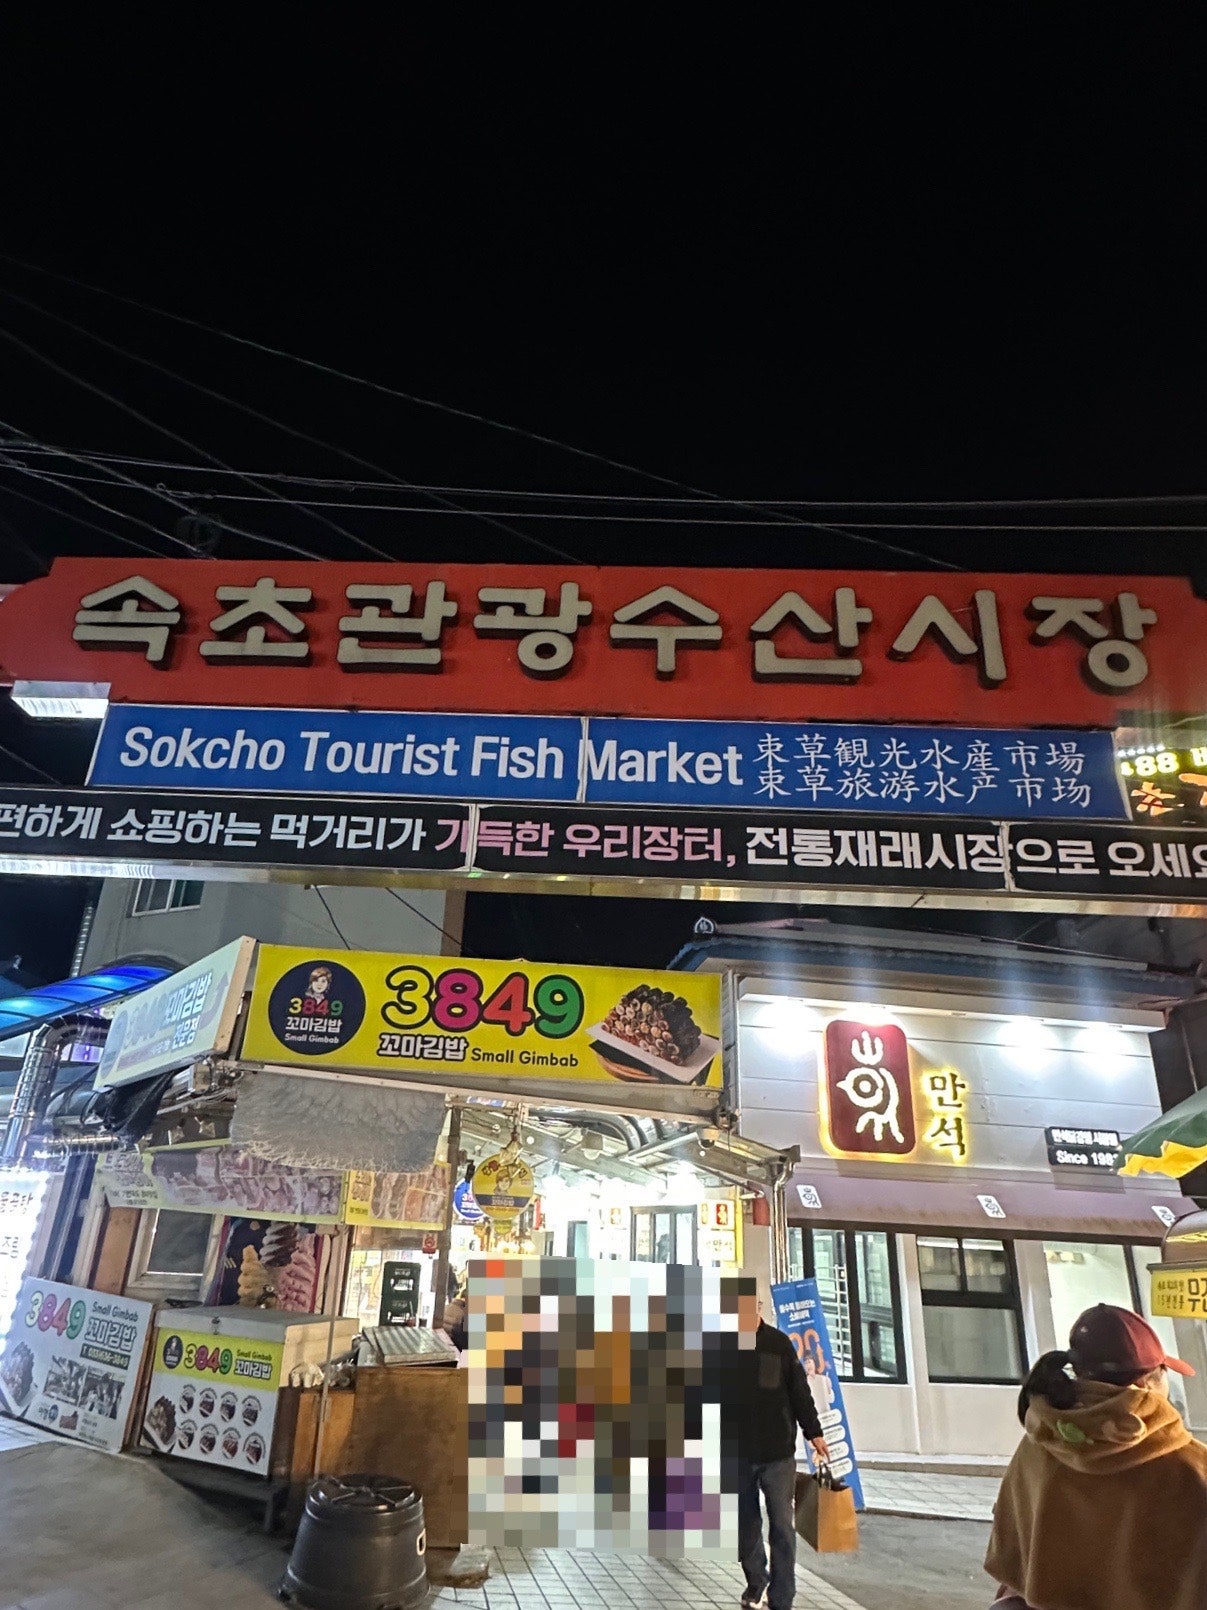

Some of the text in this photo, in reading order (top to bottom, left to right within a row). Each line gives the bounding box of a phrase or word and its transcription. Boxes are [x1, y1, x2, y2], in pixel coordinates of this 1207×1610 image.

[73, 574, 1158, 690] 속초관광수산시장
[119, 725, 743, 787] Sokcho Tourist Fish Market
[0, 803, 103, 840] 편하게
[107, 808, 262, 847] 쇼핑하는
[271, 813, 427, 852] 먹거리가
[435, 817, 555, 858] 가득한
[562, 822, 737, 868] 우리장터,
[745, 826, 1100, 876] 전통재래시장으로
[288, 997, 344, 1017] 3849
[380, 965, 585, 1039] 3849
[284, 1033, 340, 1044] Small Gimbab
[285, 1016, 343, 1034] 꼬마김밥
[376, 1033, 470, 1062] 꼬마김밥
[471, 1047, 579, 1068] Small Gimbab
[929, 1072, 966, 1156] 만석
[1056, 1149, 1089, 1165] Since
[25, 1290, 87, 1340] 3849
[92, 1301, 139, 1323] Small Gimbab
[84, 1316, 138, 1353] 꼬마김밥
[184, 1342, 233, 1376] 3849
[233, 1358, 274, 1381] 꼬마김밥
